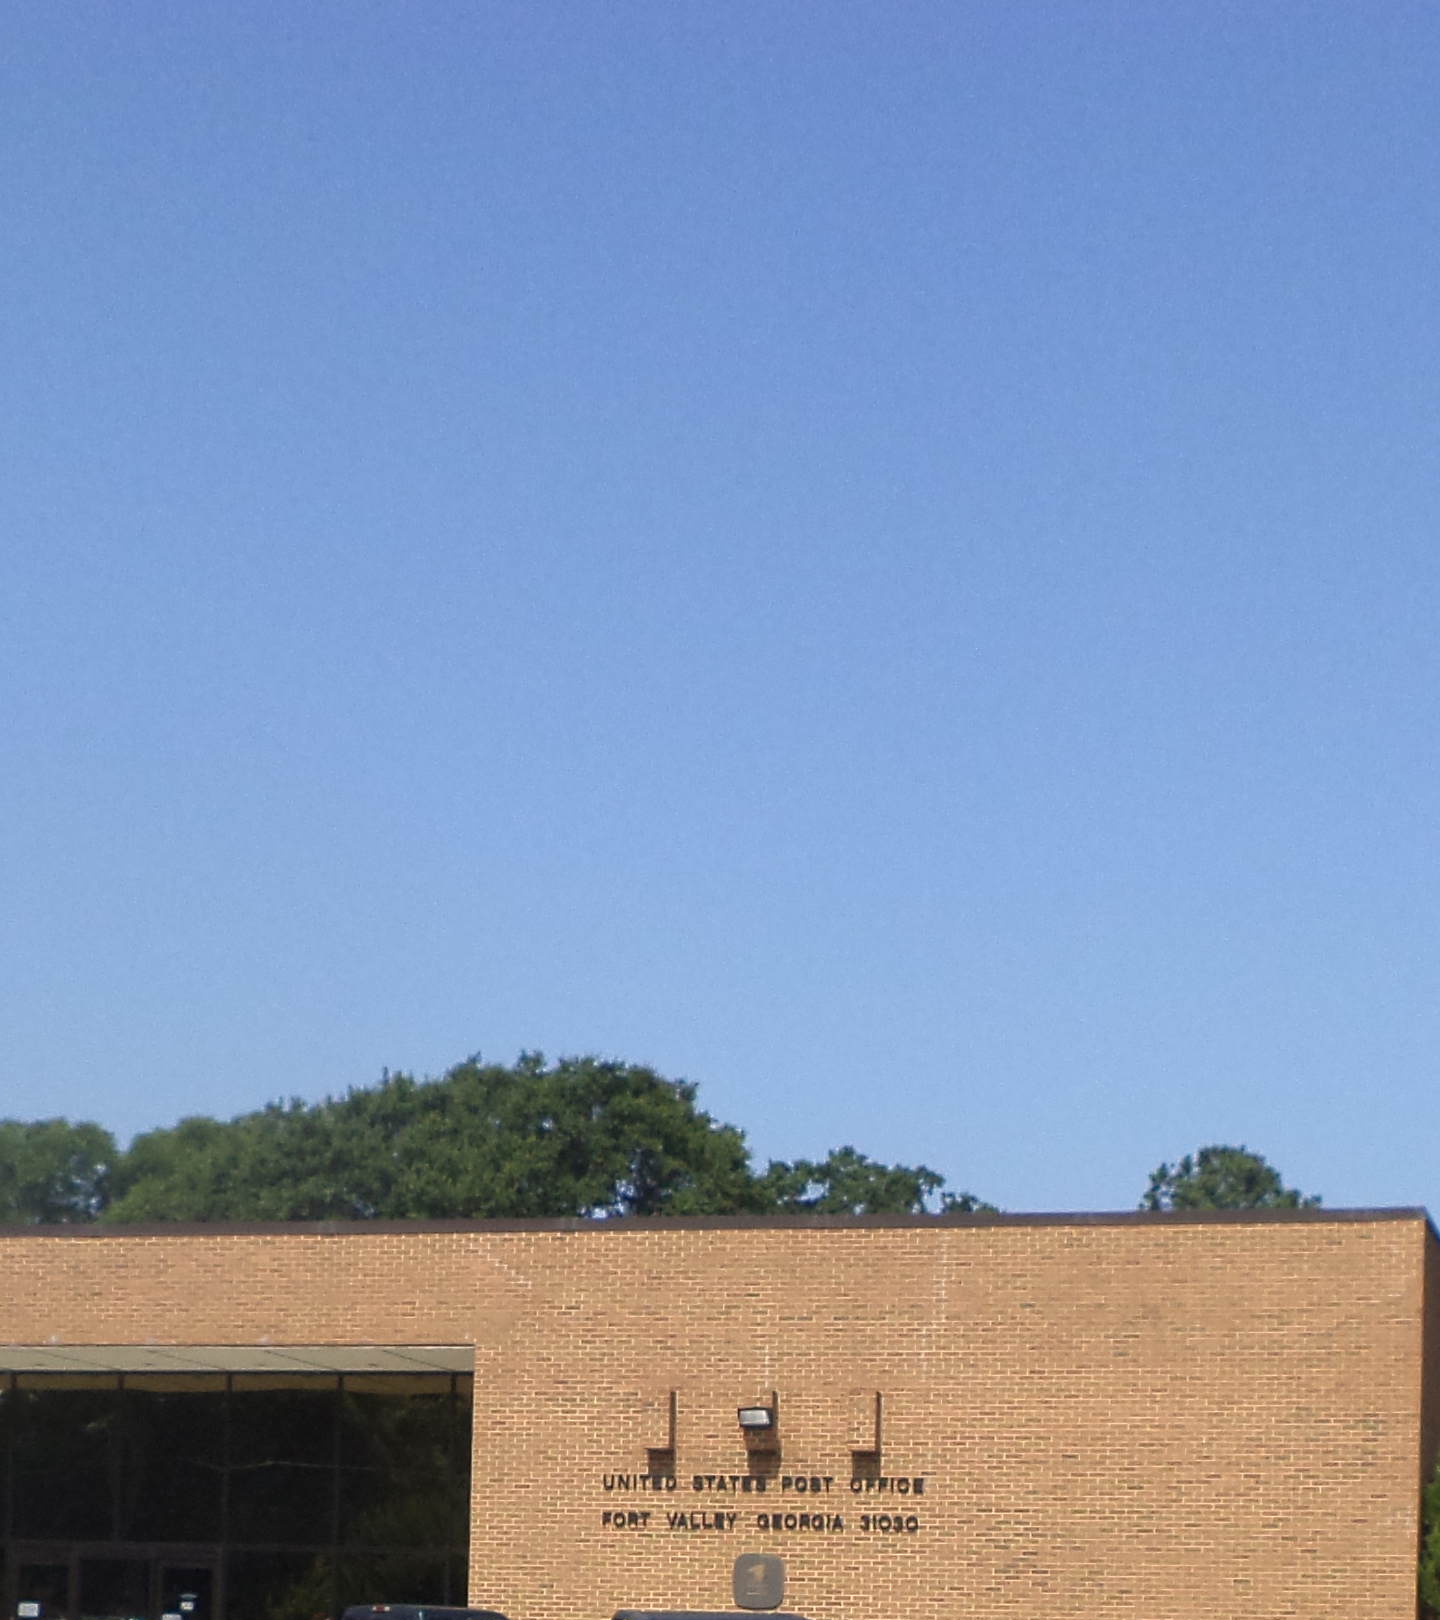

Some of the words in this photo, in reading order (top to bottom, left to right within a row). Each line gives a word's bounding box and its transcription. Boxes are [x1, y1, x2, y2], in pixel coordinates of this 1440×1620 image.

[602, 1473, 678, 1492] UNITED
[692, 1474, 767, 1493] STATES
[781, 1475, 834, 1494] POST
[849, 1476, 925, 1495] OFFICE
[601, 1511, 651, 1529] FORT
[666, 1511, 738, 1530] VALLEY
[756, 1512, 845, 1533] GEORGIA
[859, 1514, 920, 1534] 31030
